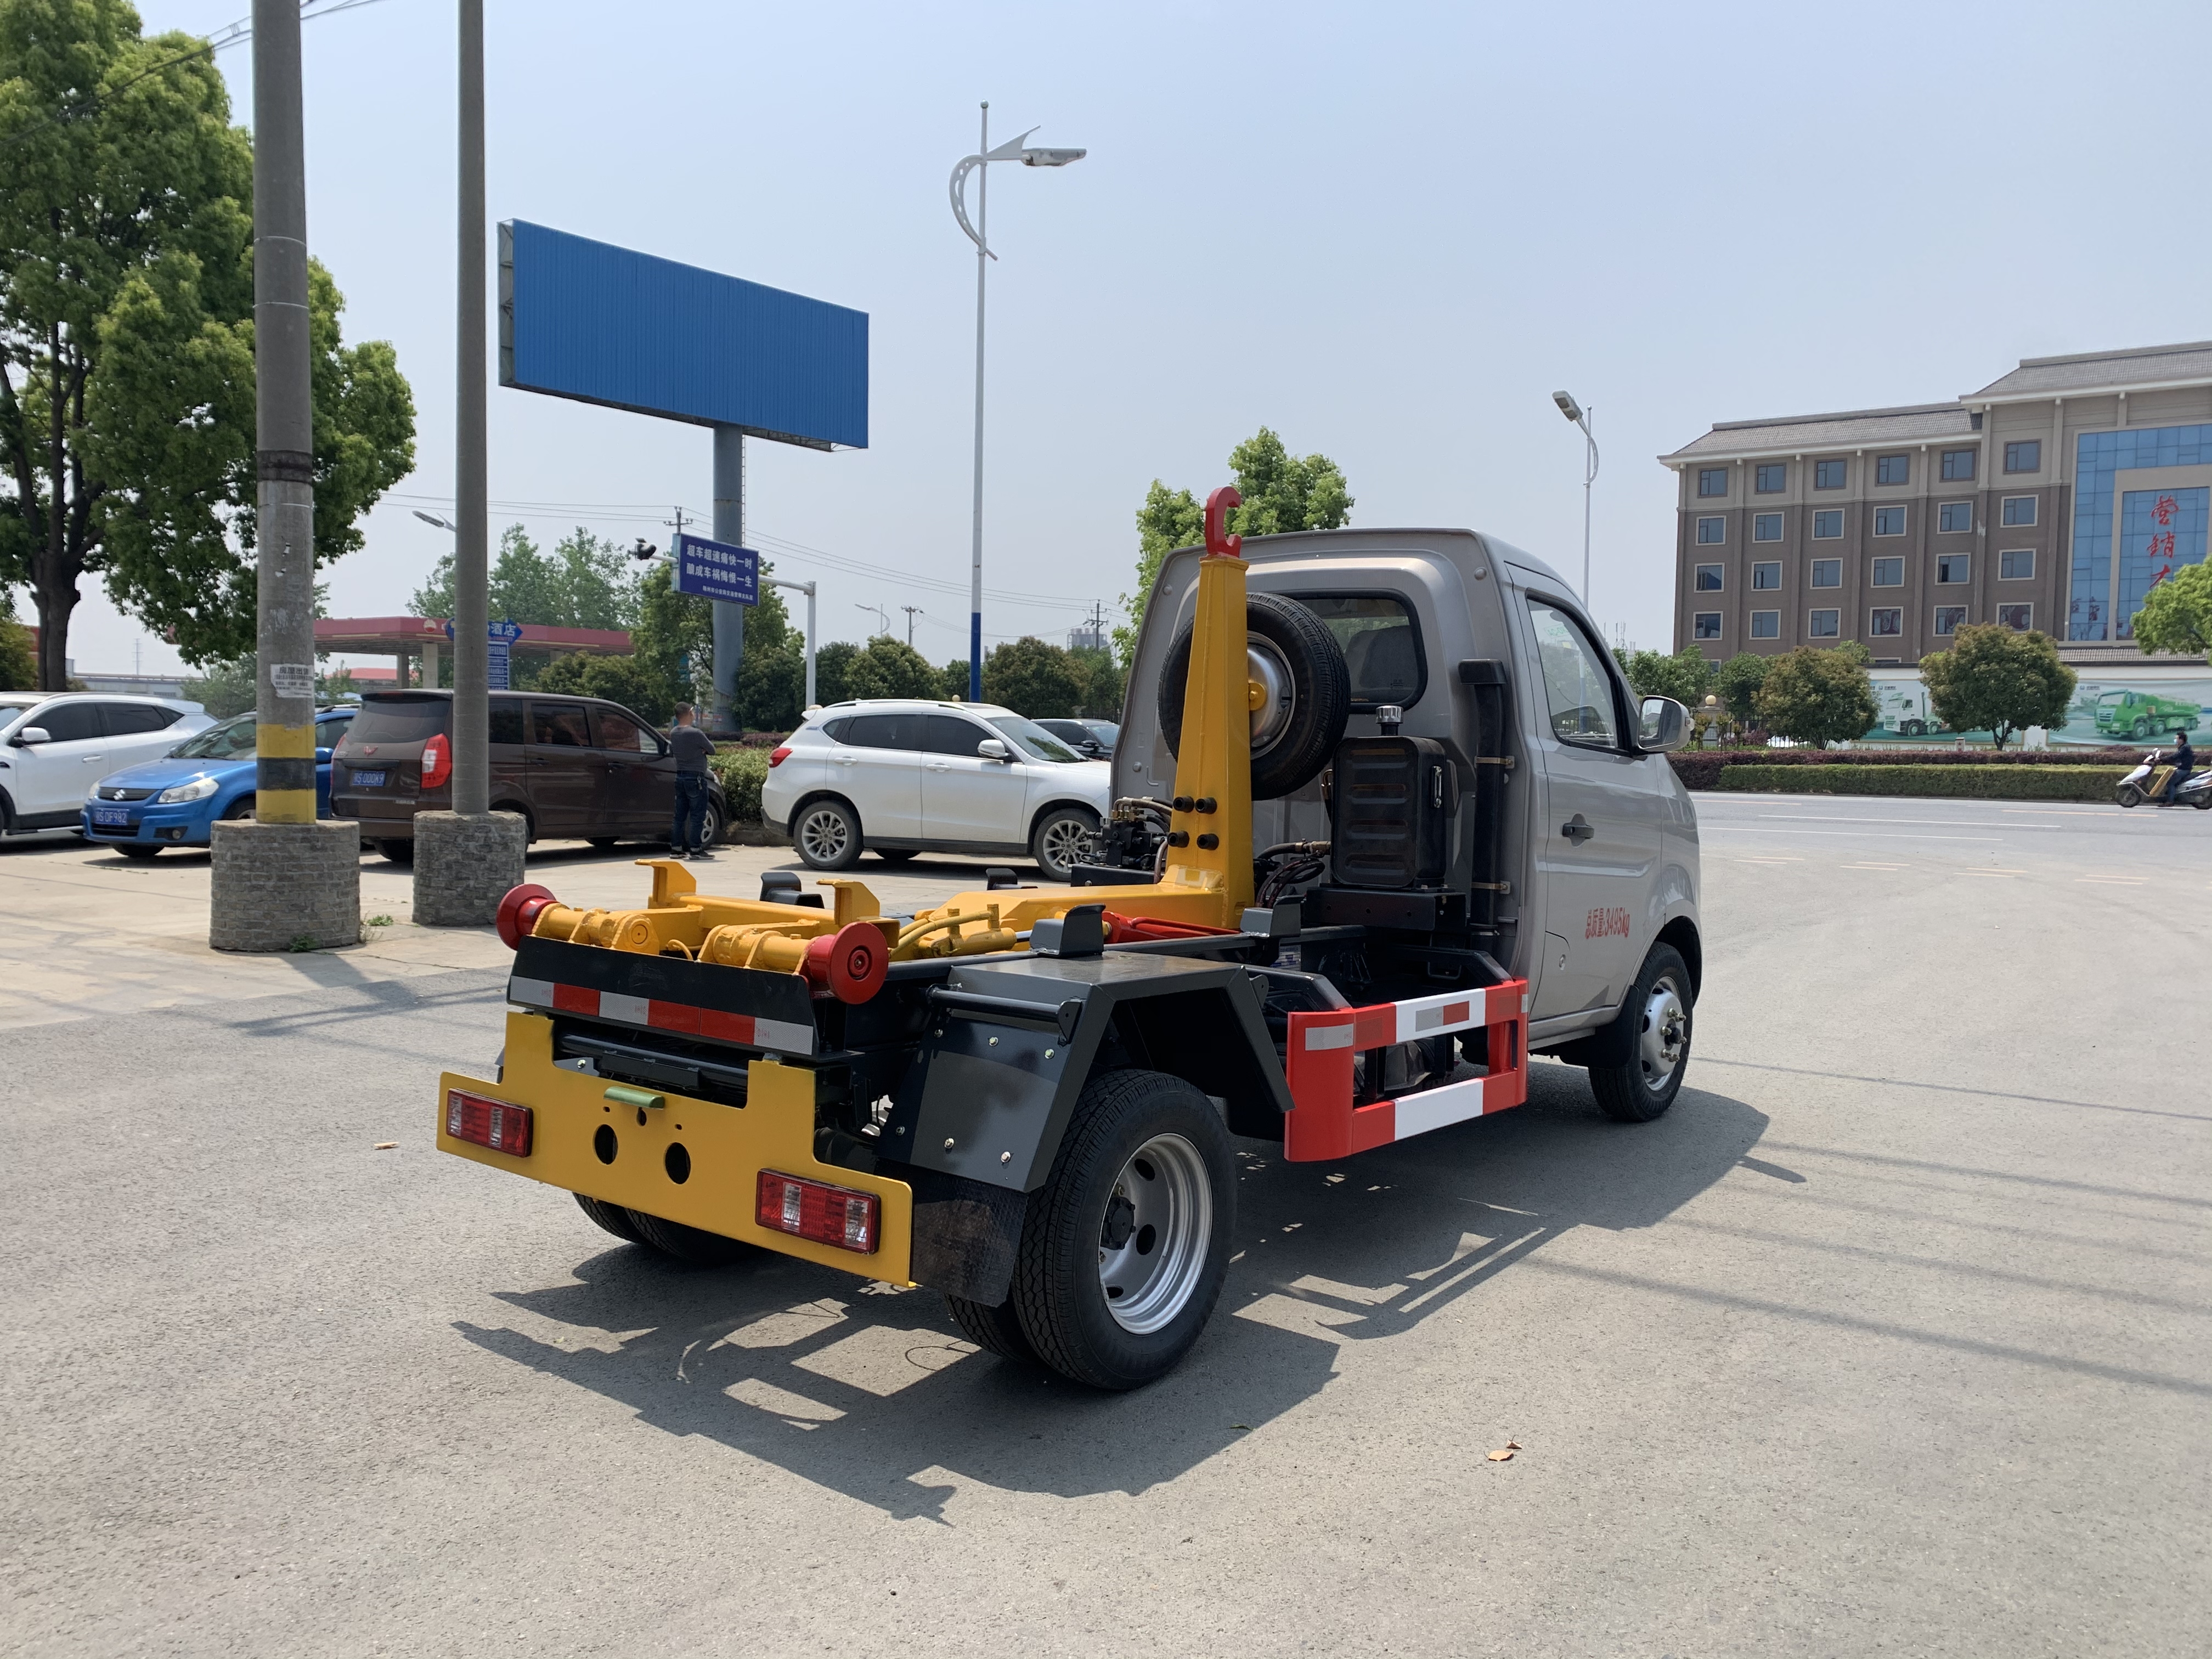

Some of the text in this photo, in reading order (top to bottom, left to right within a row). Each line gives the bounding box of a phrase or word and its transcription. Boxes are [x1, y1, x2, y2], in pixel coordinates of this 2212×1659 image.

[687, 544, 752, 569] 超车超速痛快一时
[686, 563, 752, 587] 酿成车祸悔恨一生
[487, 622, 516, 637] 酒店
